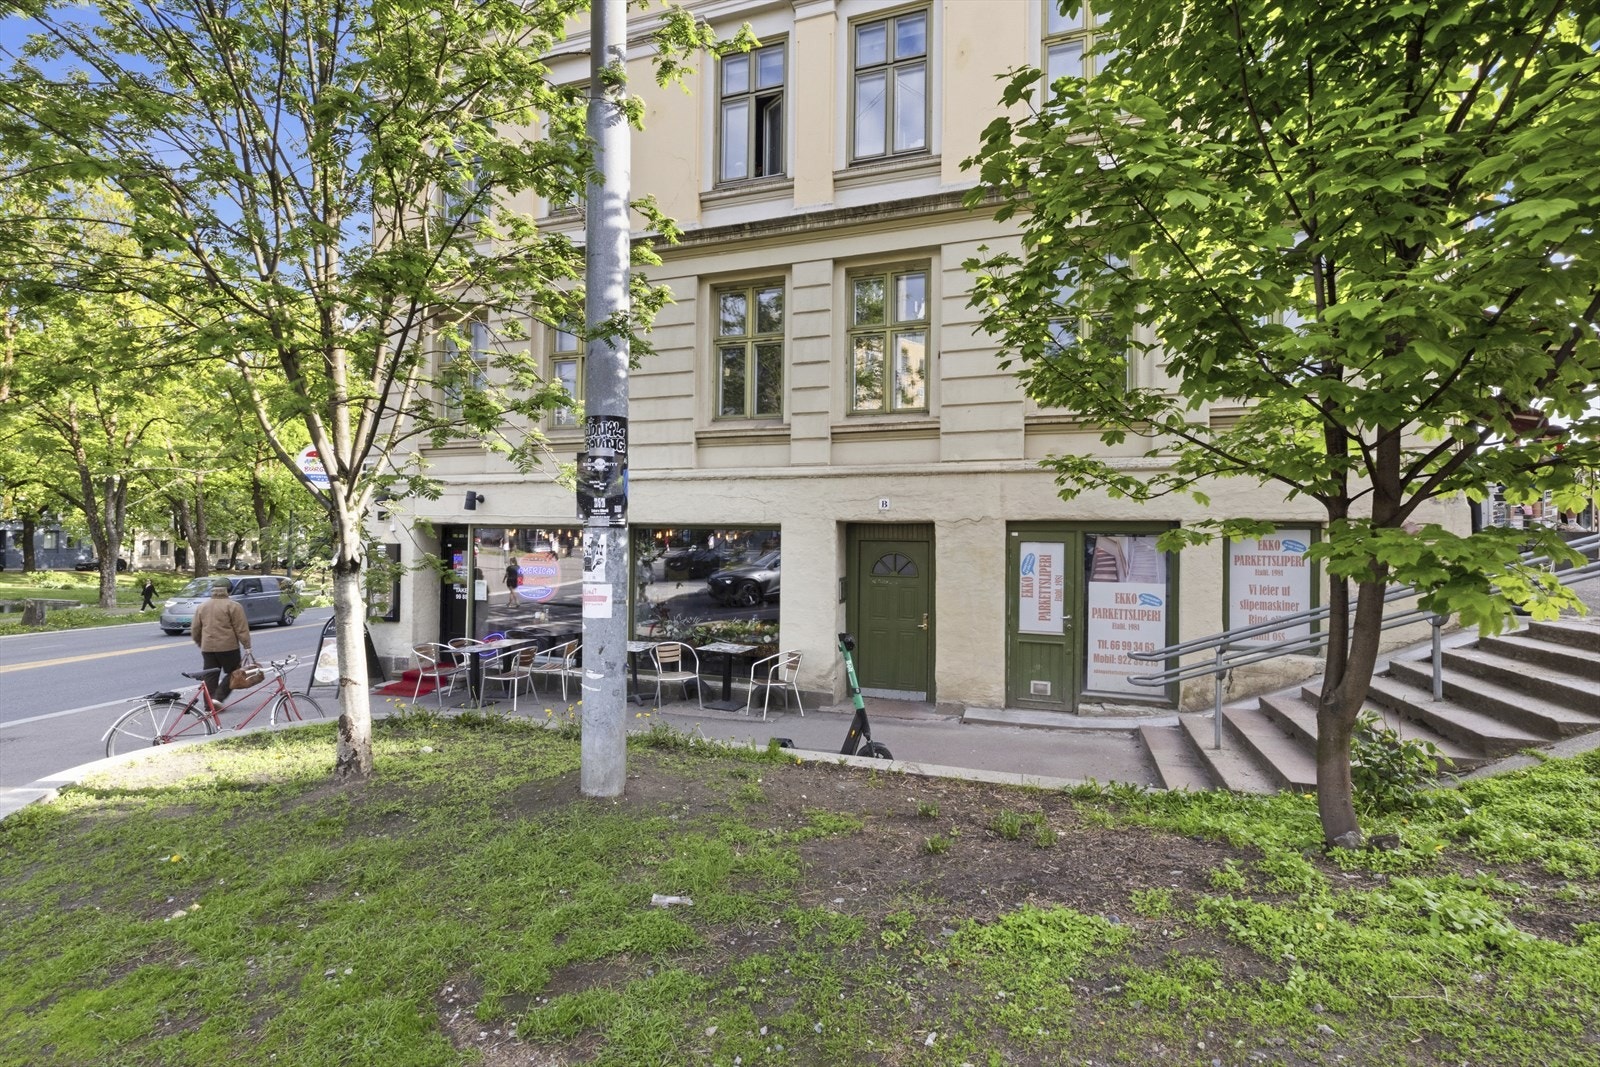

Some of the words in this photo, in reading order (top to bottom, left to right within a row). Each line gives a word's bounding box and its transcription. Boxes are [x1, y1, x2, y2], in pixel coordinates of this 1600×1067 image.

[881, 500, 888, 508] B
[1258, 540, 1280, 551] EKKO
[1234, 554, 1305, 567] PARKETTSLIPERI
[518, 566, 556, 575] AMERICAN
[1021, 576, 1034, 598] EKKO
[1038, 554, 1052, 621] PARKETTSLIPERI
[1248, 584, 1256, 595] Vi
[1260, 584, 1279, 596] leier
[1282, 586, 1290, 596] ut
[1115, 592, 1137, 604] EKKO
[1240, 600, 1300, 612] slipemaskiner
[1092, 608, 1162, 622] PARKETTSLIPERI
[1272, 632, 1286, 641] oss
[1098, 640, 1108, 649] Tlf.
[1110, 640, 1120, 650] 66
[1122, 641, 1132, 651] 99
[1134, 642, 1143, 651] 34
[1145, 642, 1154, 652] 63
[1094, 653, 1116, 664] Mobil:
[1118, 654, 1132, 666] 922
